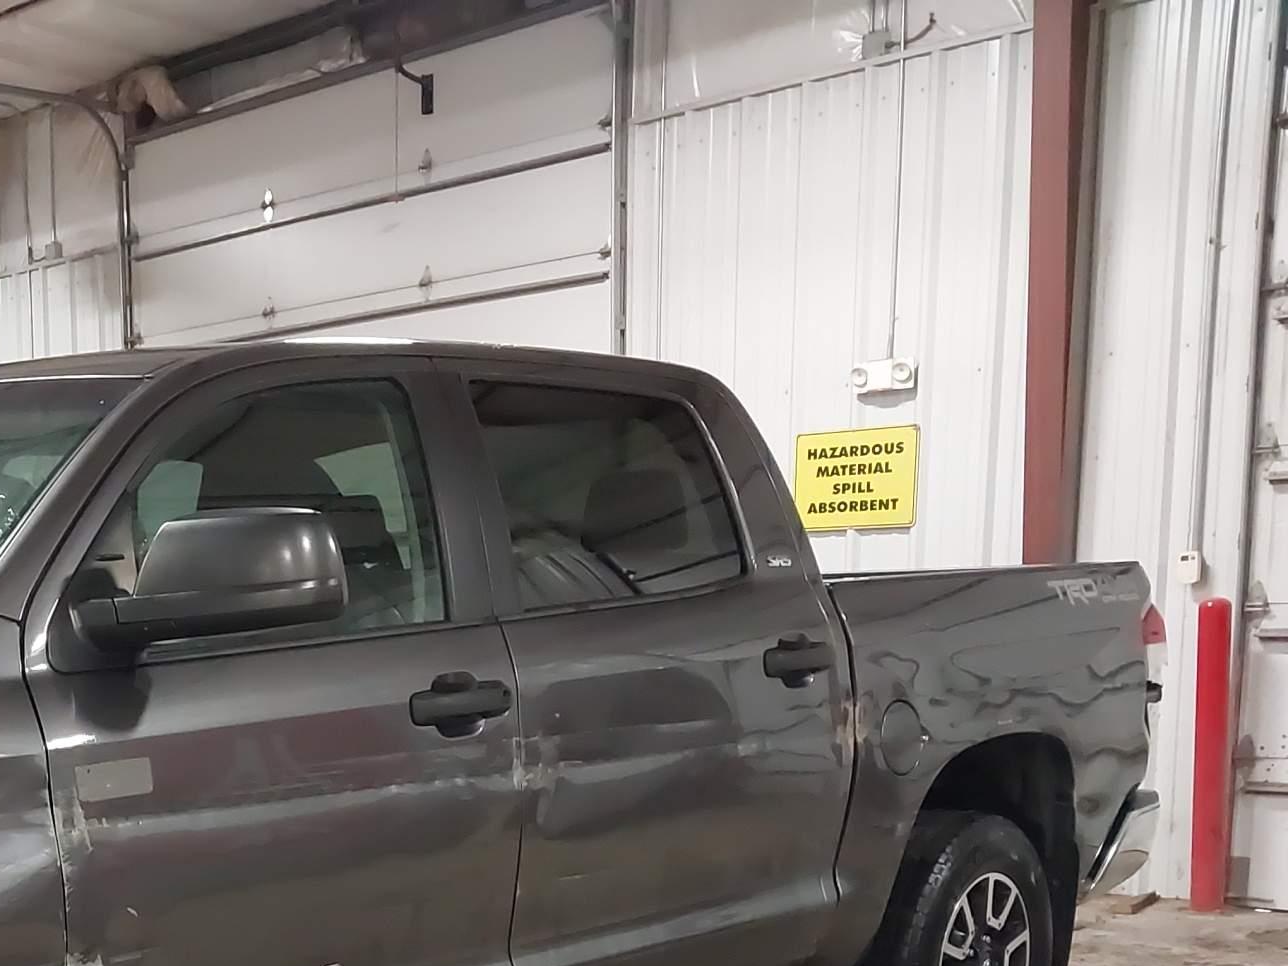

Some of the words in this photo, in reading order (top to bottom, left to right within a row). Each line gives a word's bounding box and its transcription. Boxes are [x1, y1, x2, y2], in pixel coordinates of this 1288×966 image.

[807, 441, 904, 460] HAZARDOUS
[815, 461, 893, 478] MATERIAL
[832, 481, 874, 495] SPILL
[807, 498, 899, 514] ABSORBENT
[1047, 578, 1098, 606] TRD
